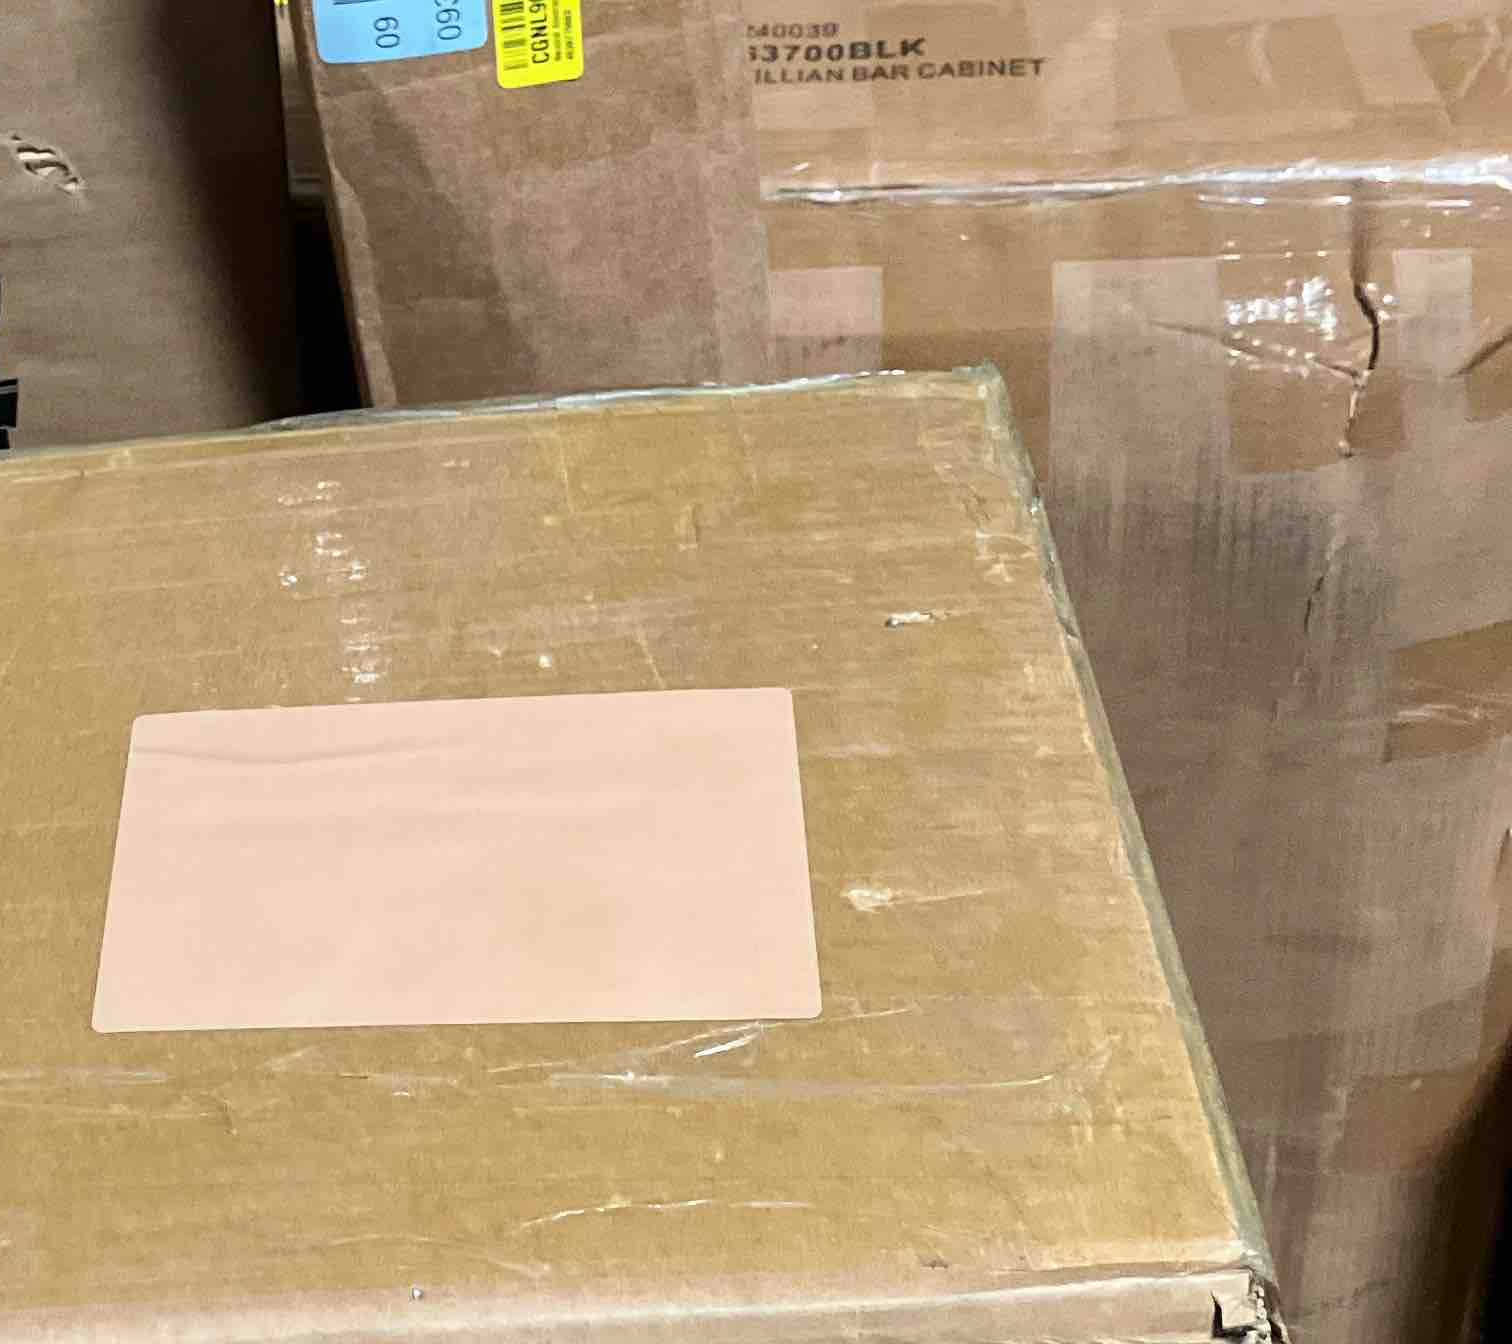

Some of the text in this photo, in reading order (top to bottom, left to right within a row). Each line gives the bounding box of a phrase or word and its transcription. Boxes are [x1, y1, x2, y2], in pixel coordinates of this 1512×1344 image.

[373, 15, 401, 49] 09
[851, 63, 911, 83] BAR
[917, 57, 1046, 81] CABINET
